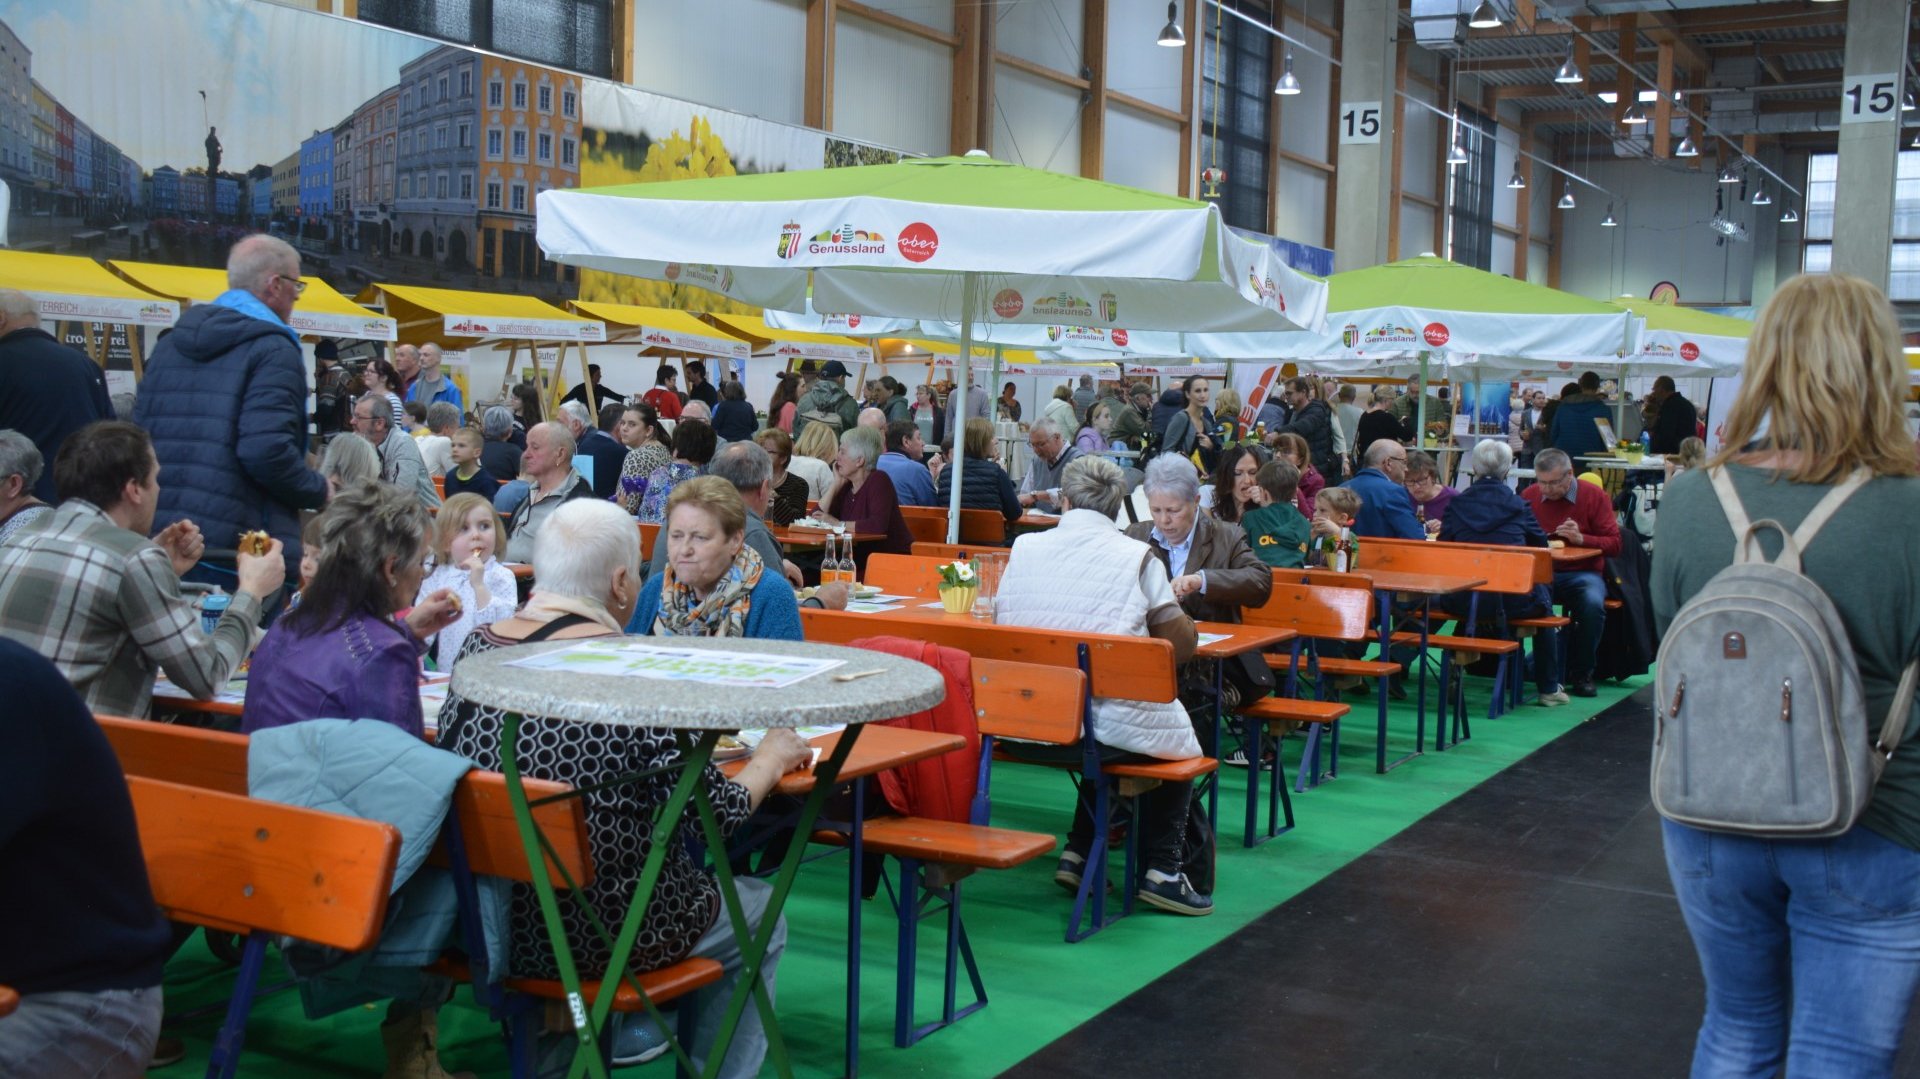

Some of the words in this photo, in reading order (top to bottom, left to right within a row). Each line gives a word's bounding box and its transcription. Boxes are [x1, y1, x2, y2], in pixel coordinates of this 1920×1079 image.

[1846, 82, 1895, 115] 15
[1343, 109, 1380, 137] 15
[809, 243, 885, 254] Genussland
[1066, 333, 1105, 342] Genussland
